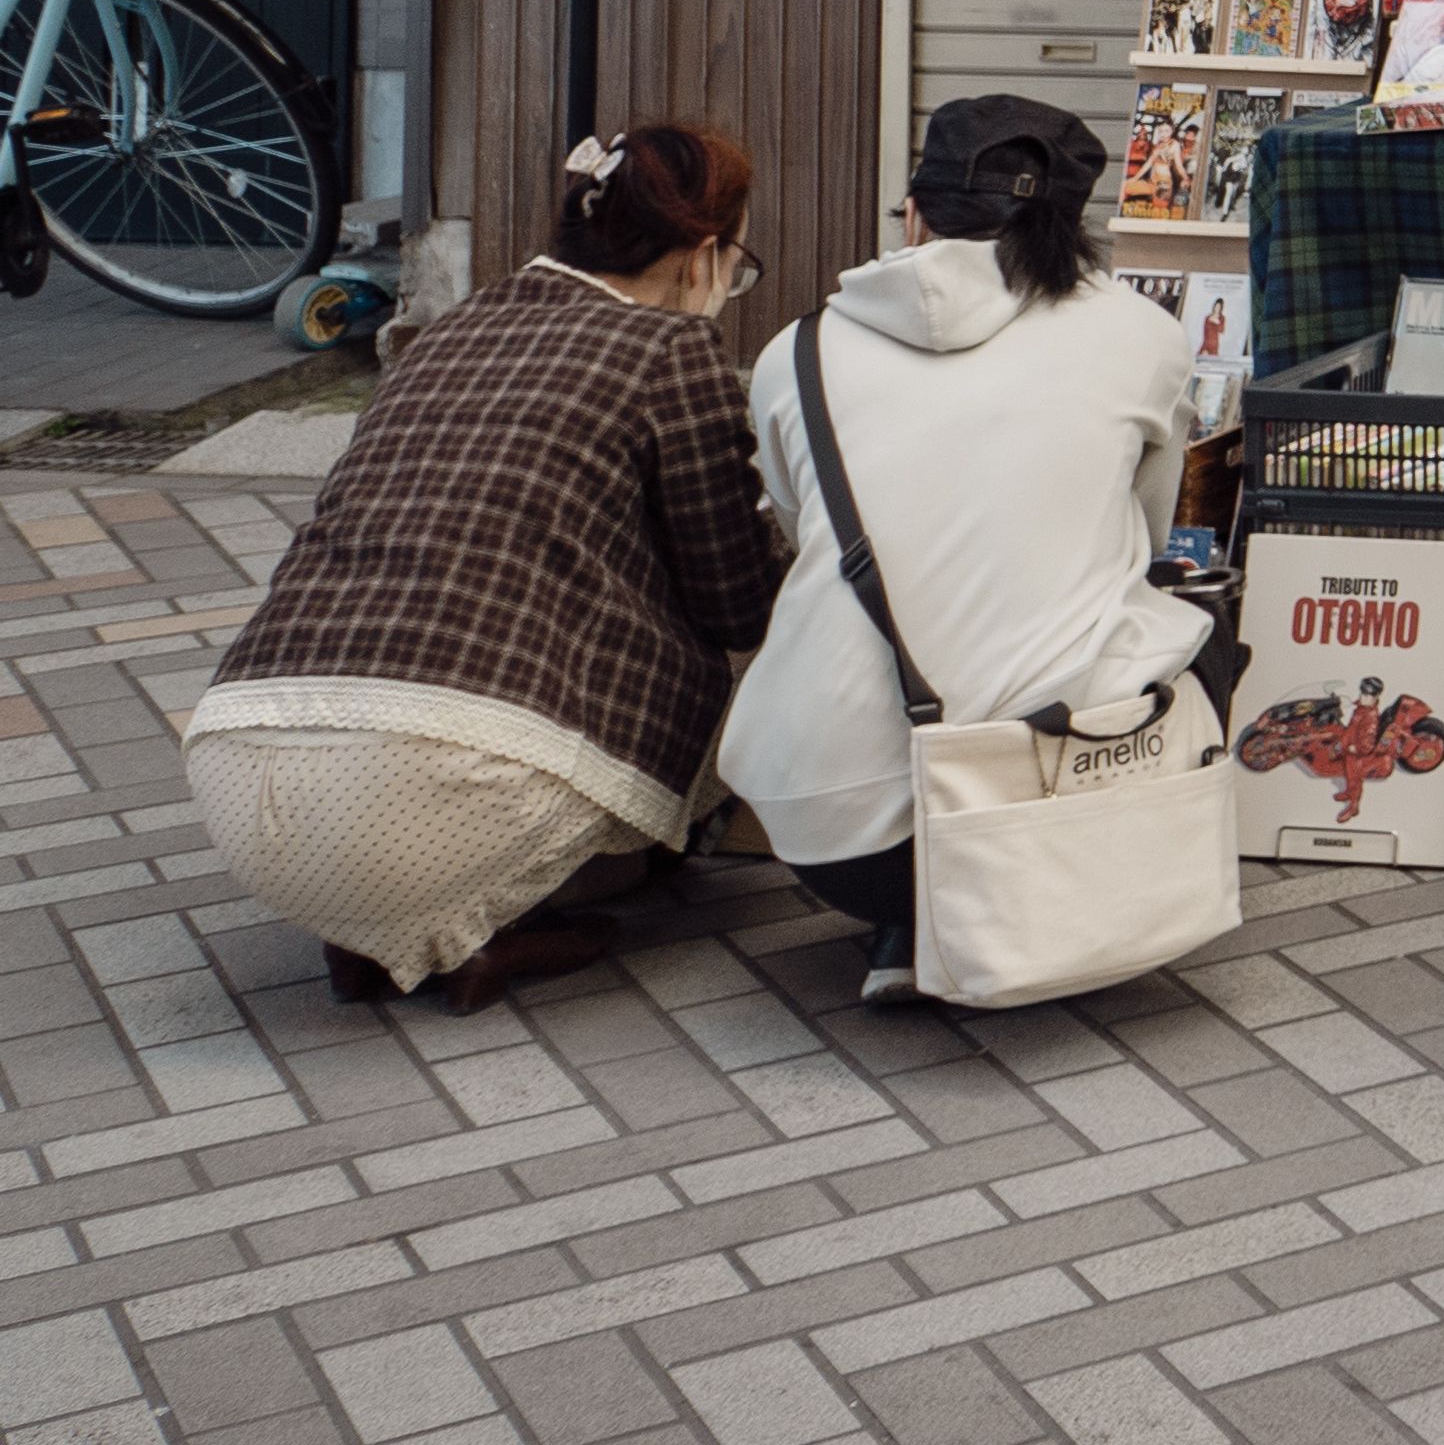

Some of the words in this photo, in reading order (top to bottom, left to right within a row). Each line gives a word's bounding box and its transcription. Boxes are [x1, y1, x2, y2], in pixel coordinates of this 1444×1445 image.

[1321, 576, 1378, 597] TRIBUTE
[1382, 579, 1399, 597] TO
[1291, 597, 1421, 649] OTOMO
[1072, 732, 1165, 776] anello
